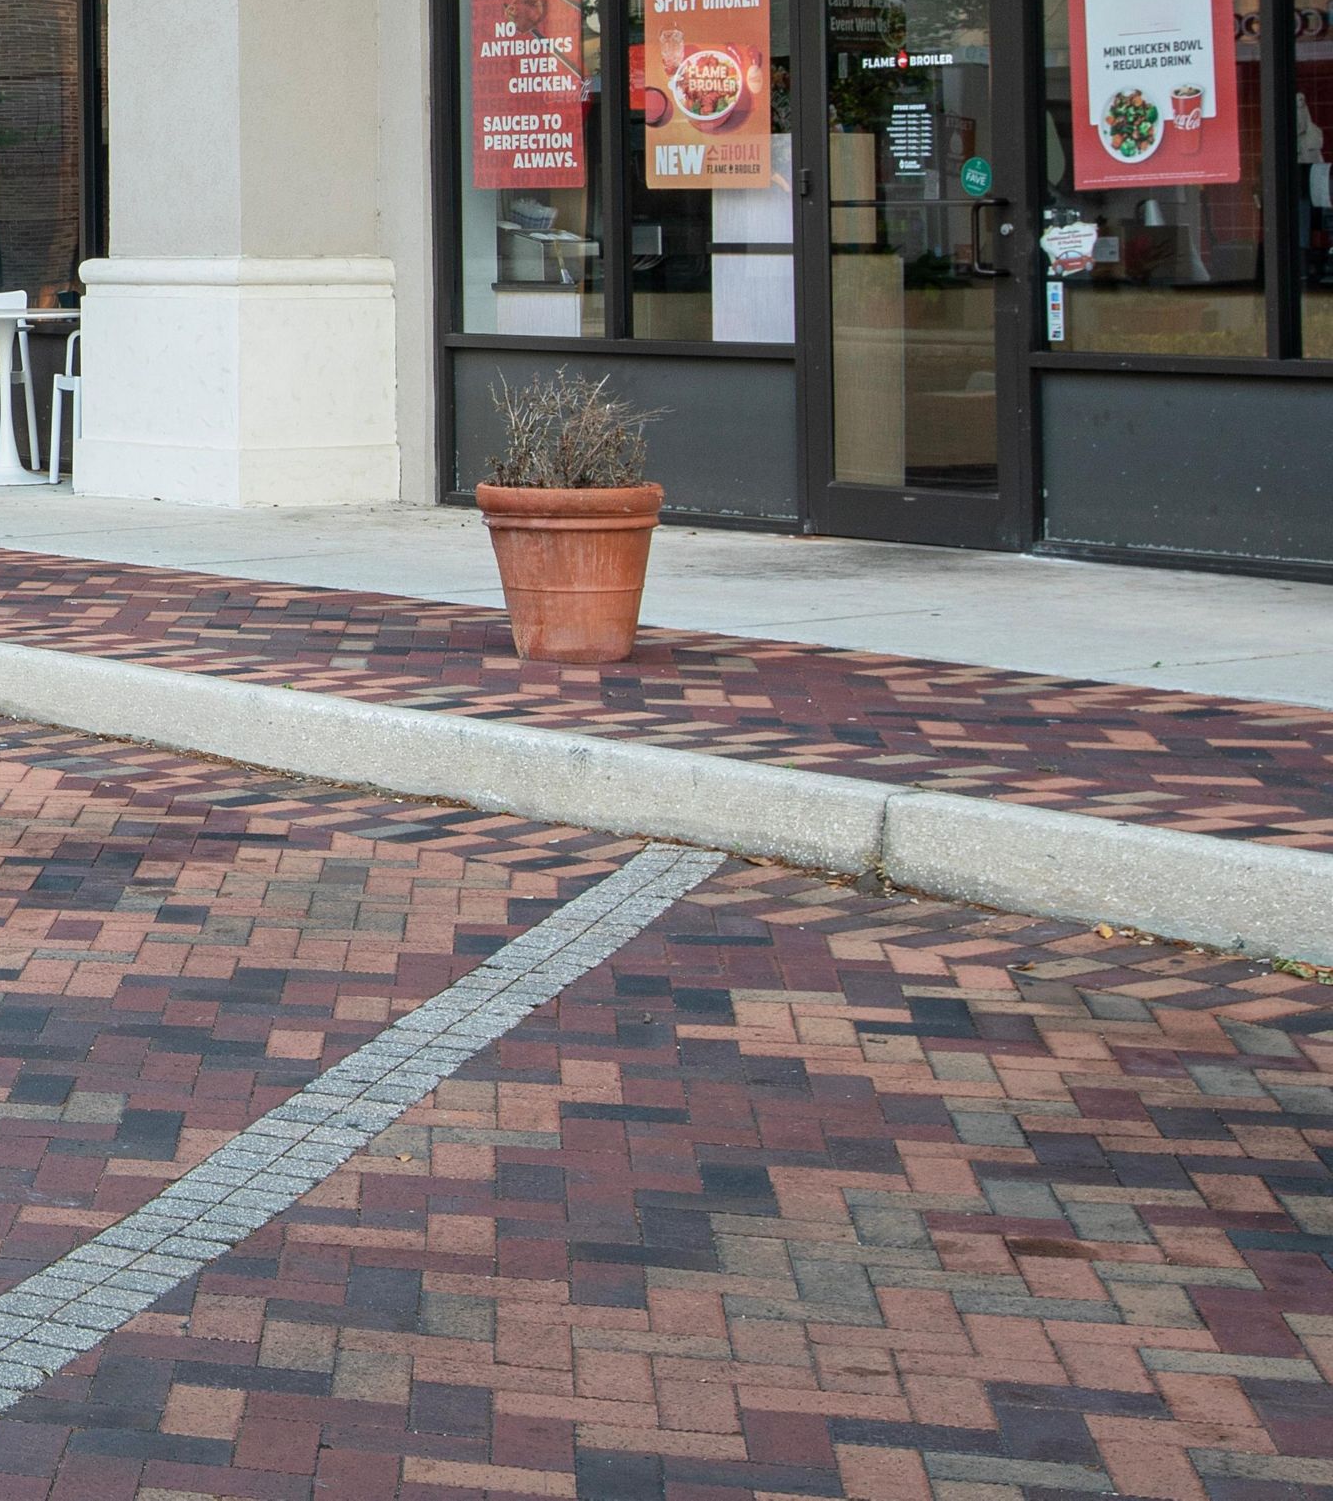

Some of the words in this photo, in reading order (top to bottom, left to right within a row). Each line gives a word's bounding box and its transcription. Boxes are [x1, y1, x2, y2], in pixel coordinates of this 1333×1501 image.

[495, 22, 517, 38] NO
[830, 16, 854, 32] Event
[855, 17, 876, 32] With
[480, 37, 573, 58] ANTIBIOTICS
[1103, 45, 1127, 57] MINI
[1128, 42, 1171, 56] CHICKEN
[1173, 39, 1203, 52] BOWL
[520, 57, 558, 74] EVER
[862, 57, 896, 69] FLAME
[909, 54, 953, 67] BROILER
[1113, 57, 1158, 71] REGULAR
[1160, 54, 1192, 68] DRINK
[688, 66, 727, 78] FLAME
[509, 75, 577, 93] CHICKEN.
[688, 80, 736, 92] BROILER
[483, 115, 540, 132] SAUCED
[542, 113, 563, 130] TO
[484, 133, 573, 151] PERFECTION
[513, 151, 578, 169] ALWAYS.
[655, 145, 705, 176] NEW
[706, 143, 761, 161] 스파이시
[706, 164, 727, 174] FLAME
[734, 164, 761, 174] BROILER
[965, 171, 987, 186] FAVE
